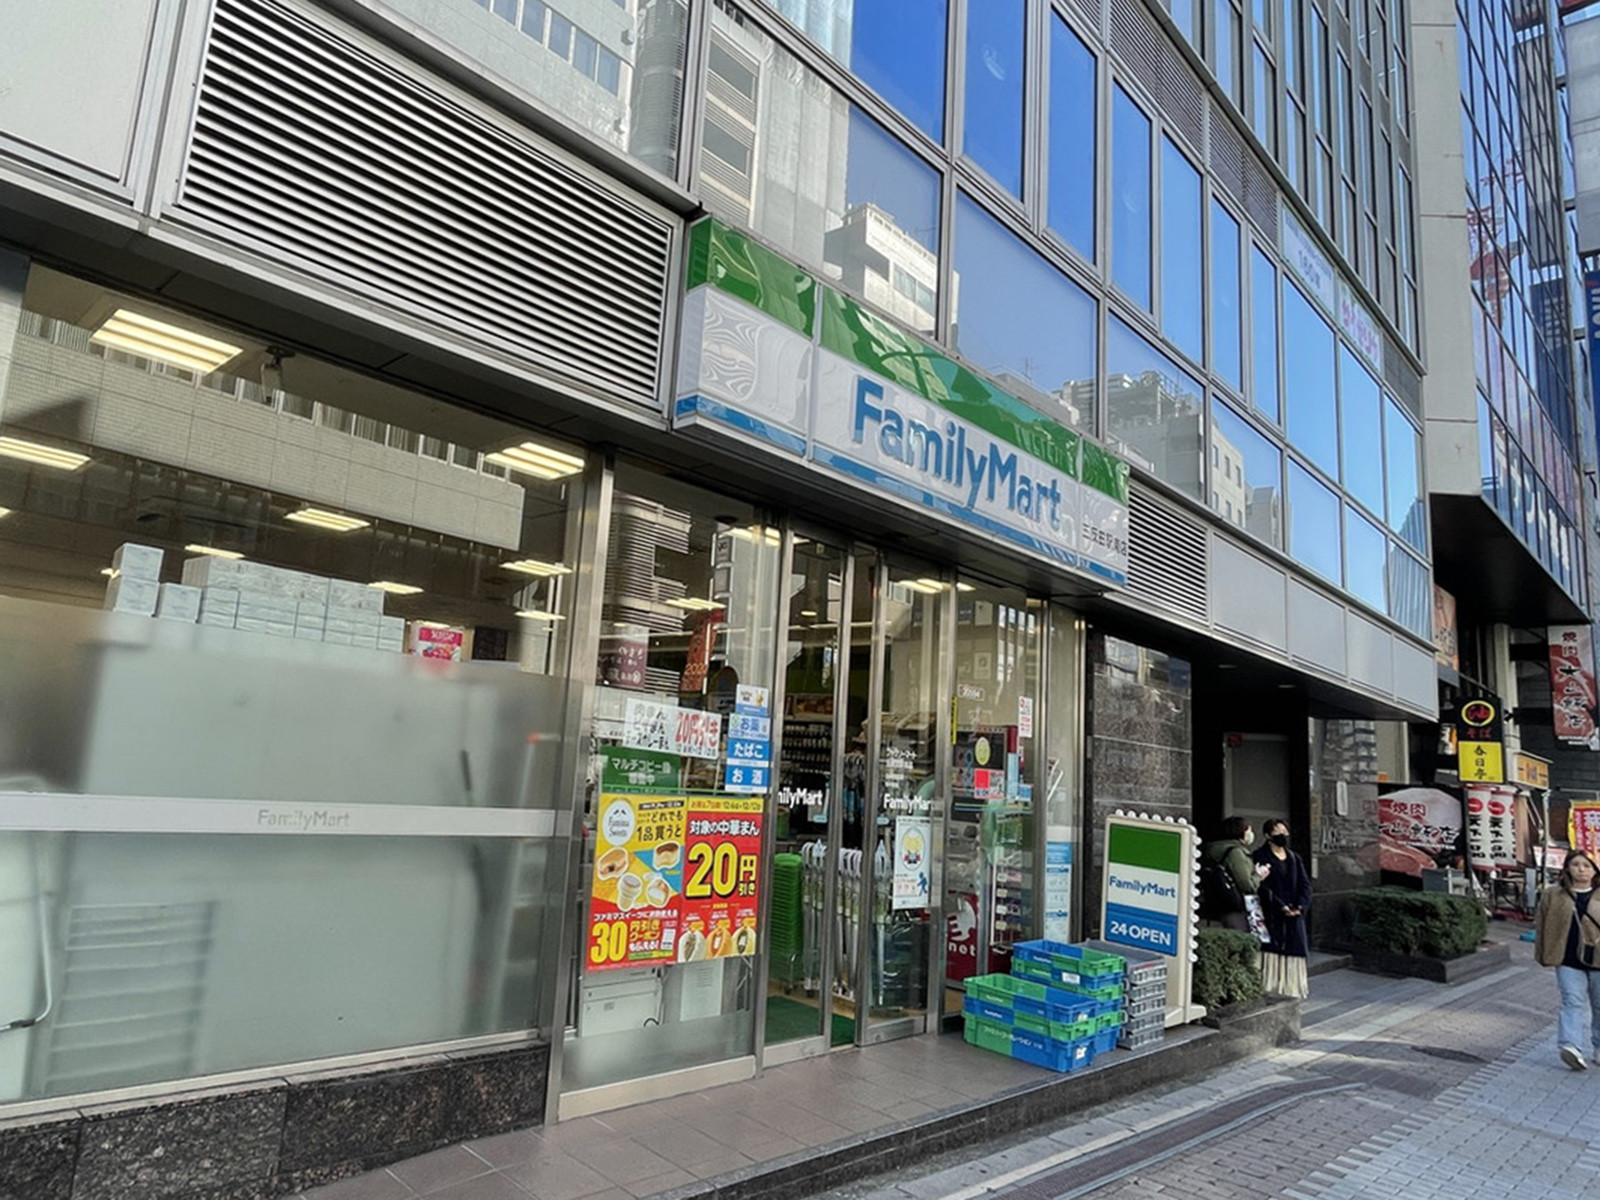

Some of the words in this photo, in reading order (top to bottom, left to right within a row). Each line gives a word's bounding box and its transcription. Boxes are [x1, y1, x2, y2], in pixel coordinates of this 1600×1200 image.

[853, 374, 1063, 528] FamilyMart
[734, 743, 763, 758] たばこ
[1474, 744, 1487, 779] 春日亭
[883, 794, 932, 814] FamilyMar
[1391, 801, 1427, 817] 焼肉
[258, 809, 350, 831] FamilyMart
[651, 810, 683, 823] どれでも
[637, 824, 682, 842] 1品買うと
[690, 820, 760, 836] 対象の中華まん
[1109, 875, 1176, 898] FamilyMart
[1129, 925, 1172, 946] OPEN
